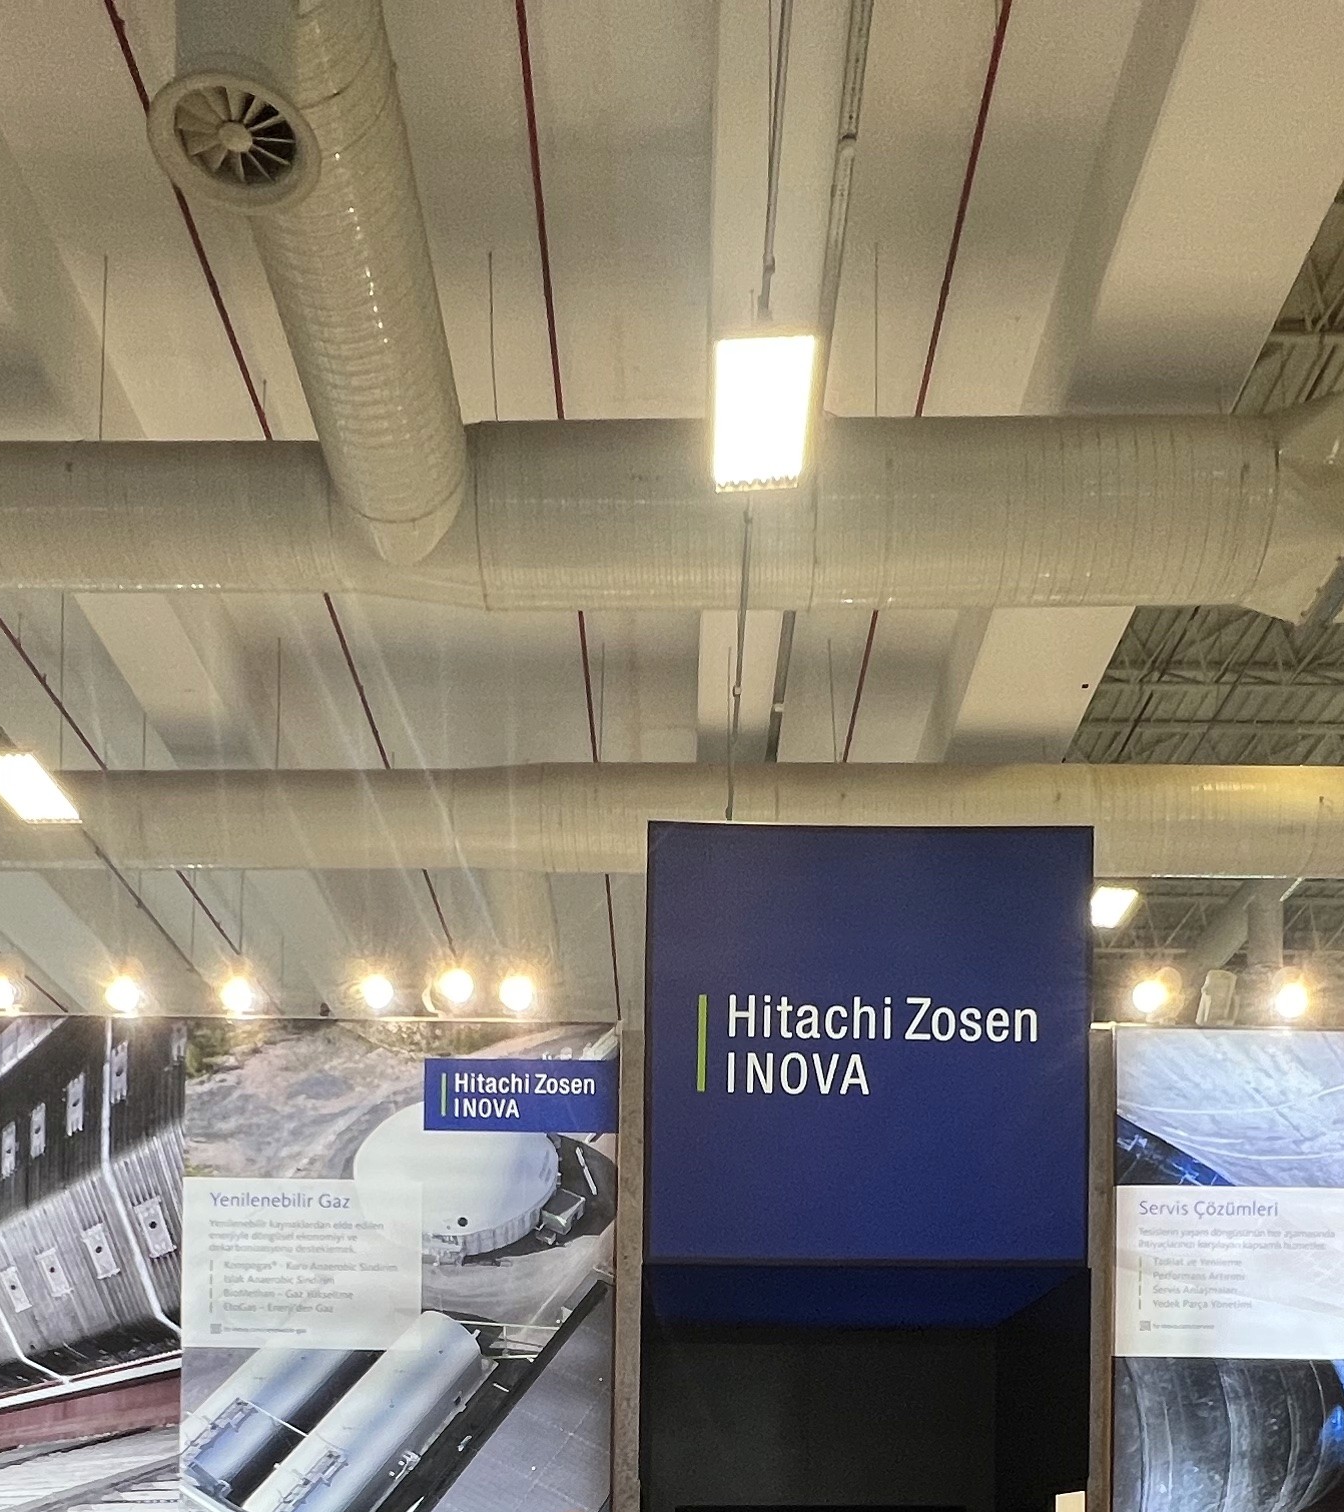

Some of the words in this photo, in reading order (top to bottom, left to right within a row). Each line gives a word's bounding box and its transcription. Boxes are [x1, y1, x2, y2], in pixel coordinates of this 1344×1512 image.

[727, 993, 892, 1040] Hitachi
[904, 996, 1038, 1043] Zosen
[454, 1072, 530, 1094] Hitachi
[534, 1073, 596, 1095] Zosen
[726, 1052, 870, 1095] INOVA
[454, 1097, 520, 1119] INOVA
[209, 1192, 313, 1208] Yenilenebilir
[318, 1193, 351, 1209] Gaz
[1138, 1200, 1188, 1216] Servis
[1193, 1201, 1279, 1219] Çözümleri
